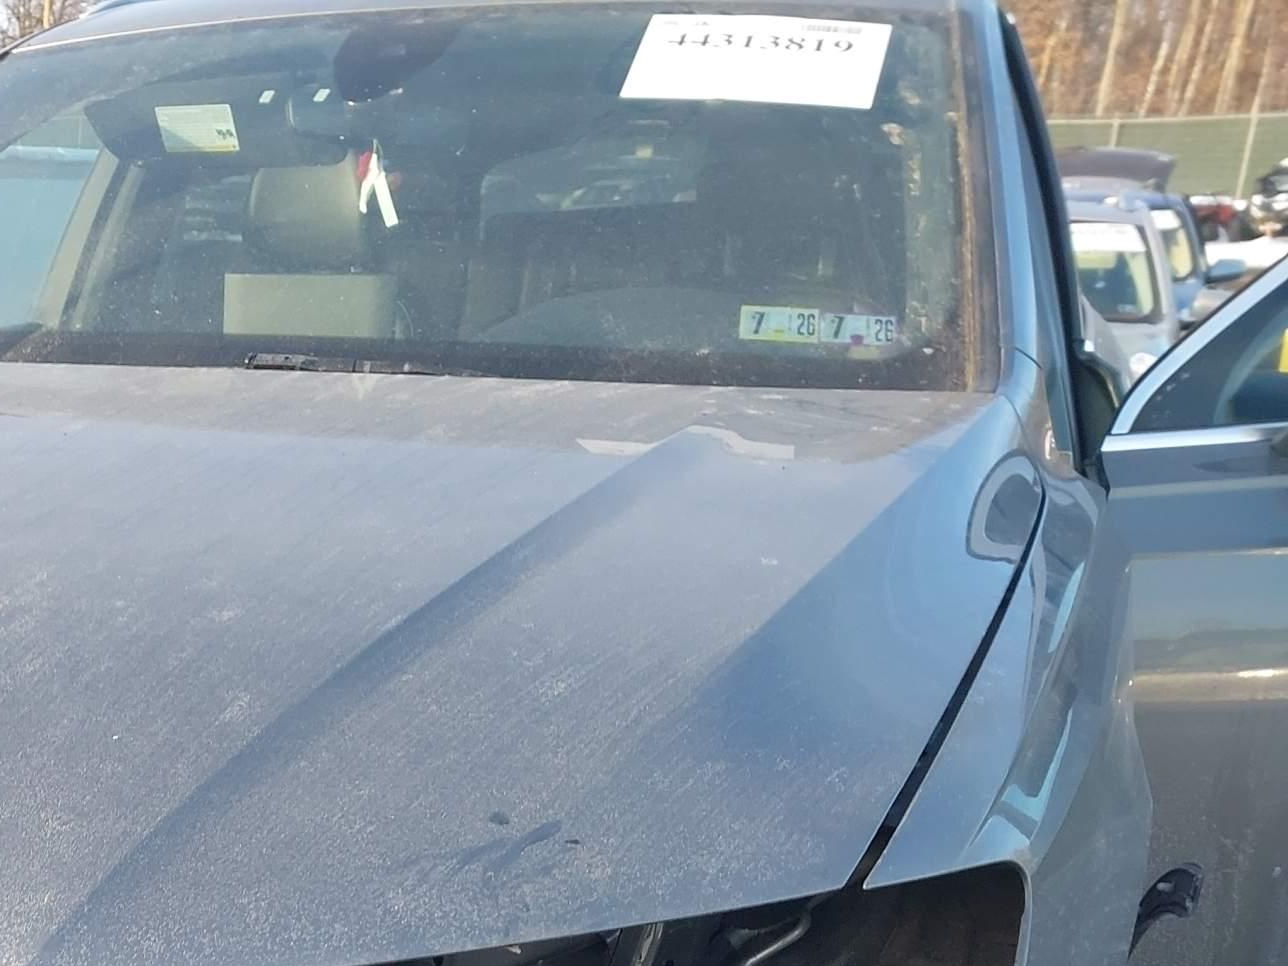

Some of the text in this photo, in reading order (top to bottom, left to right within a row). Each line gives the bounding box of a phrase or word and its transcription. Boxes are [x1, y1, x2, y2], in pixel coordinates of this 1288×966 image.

[667, 33, 856, 52] 44313819
[751, 312, 816, 336] 7 26
[830, 316, 894, 342] 7 26
